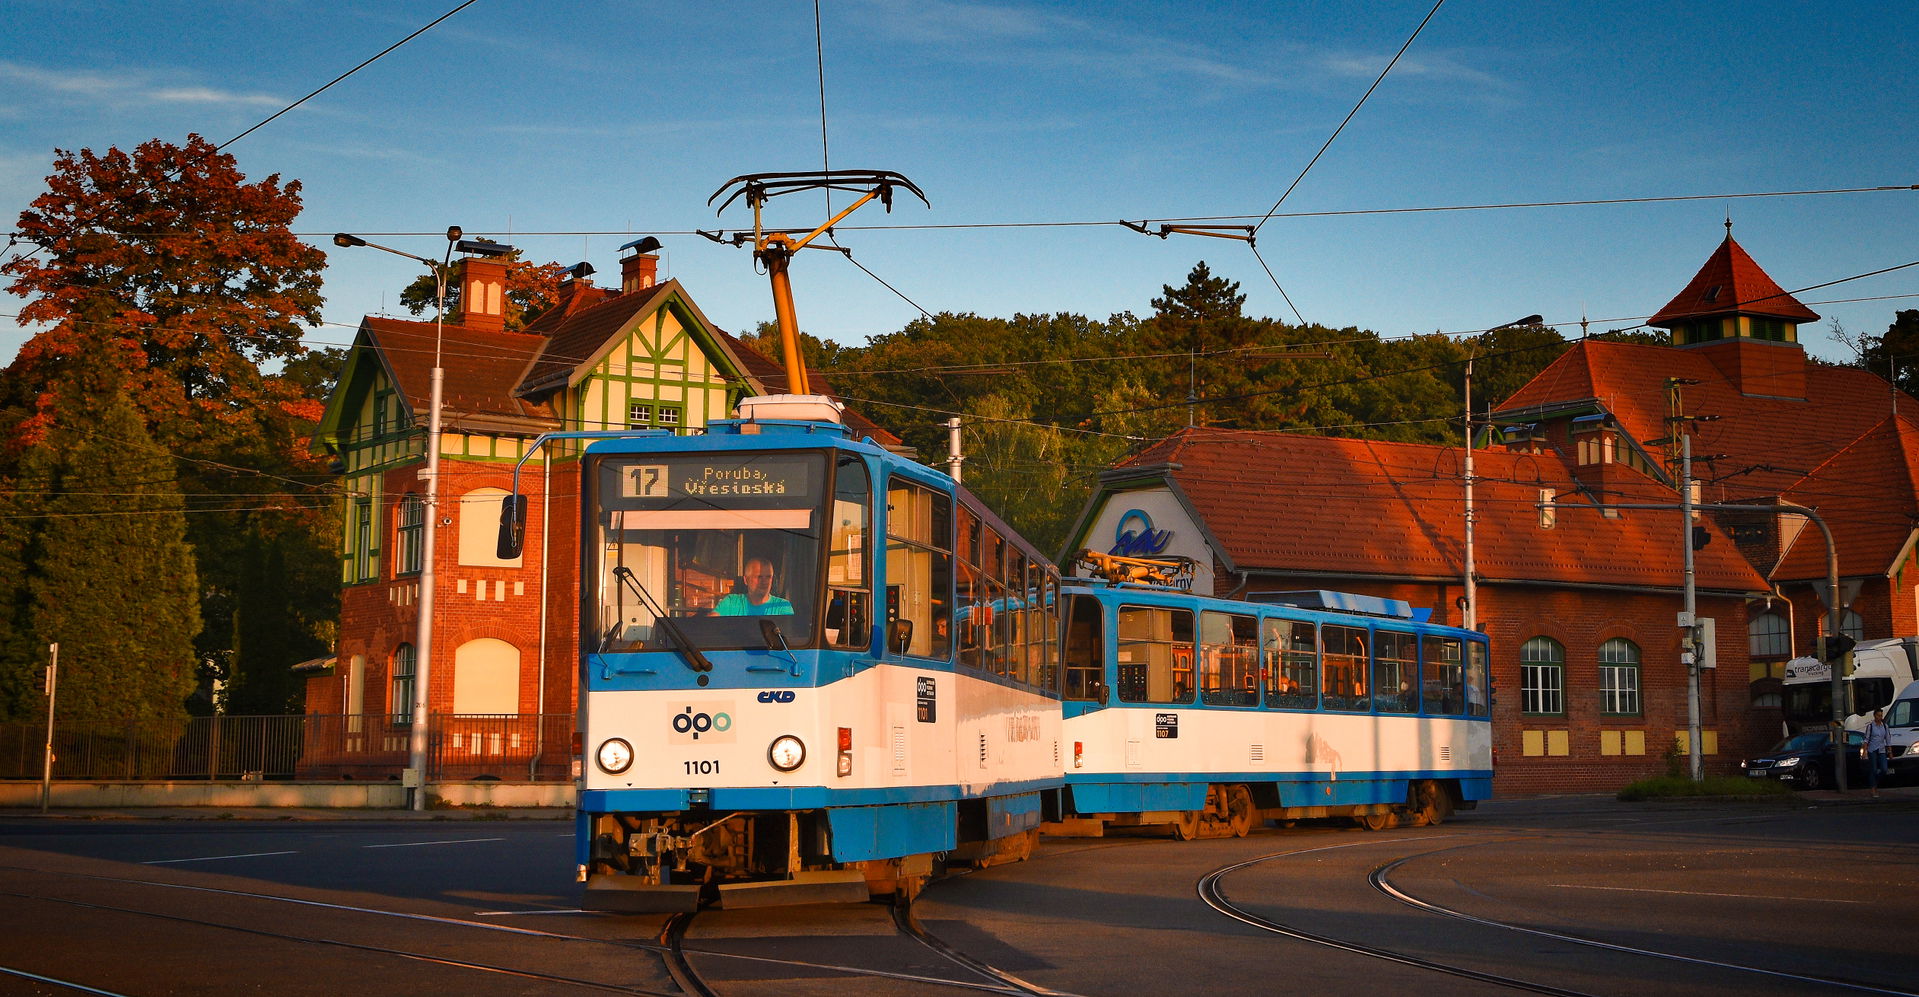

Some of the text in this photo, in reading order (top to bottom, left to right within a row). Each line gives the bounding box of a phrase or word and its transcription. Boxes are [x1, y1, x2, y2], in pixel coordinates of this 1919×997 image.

[630, 468, 659, 496] 17
[704, 467, 767, 480] Poruba,
[672, 706, 732, 740] dpo
[684, 760, 720, 775] 1101
